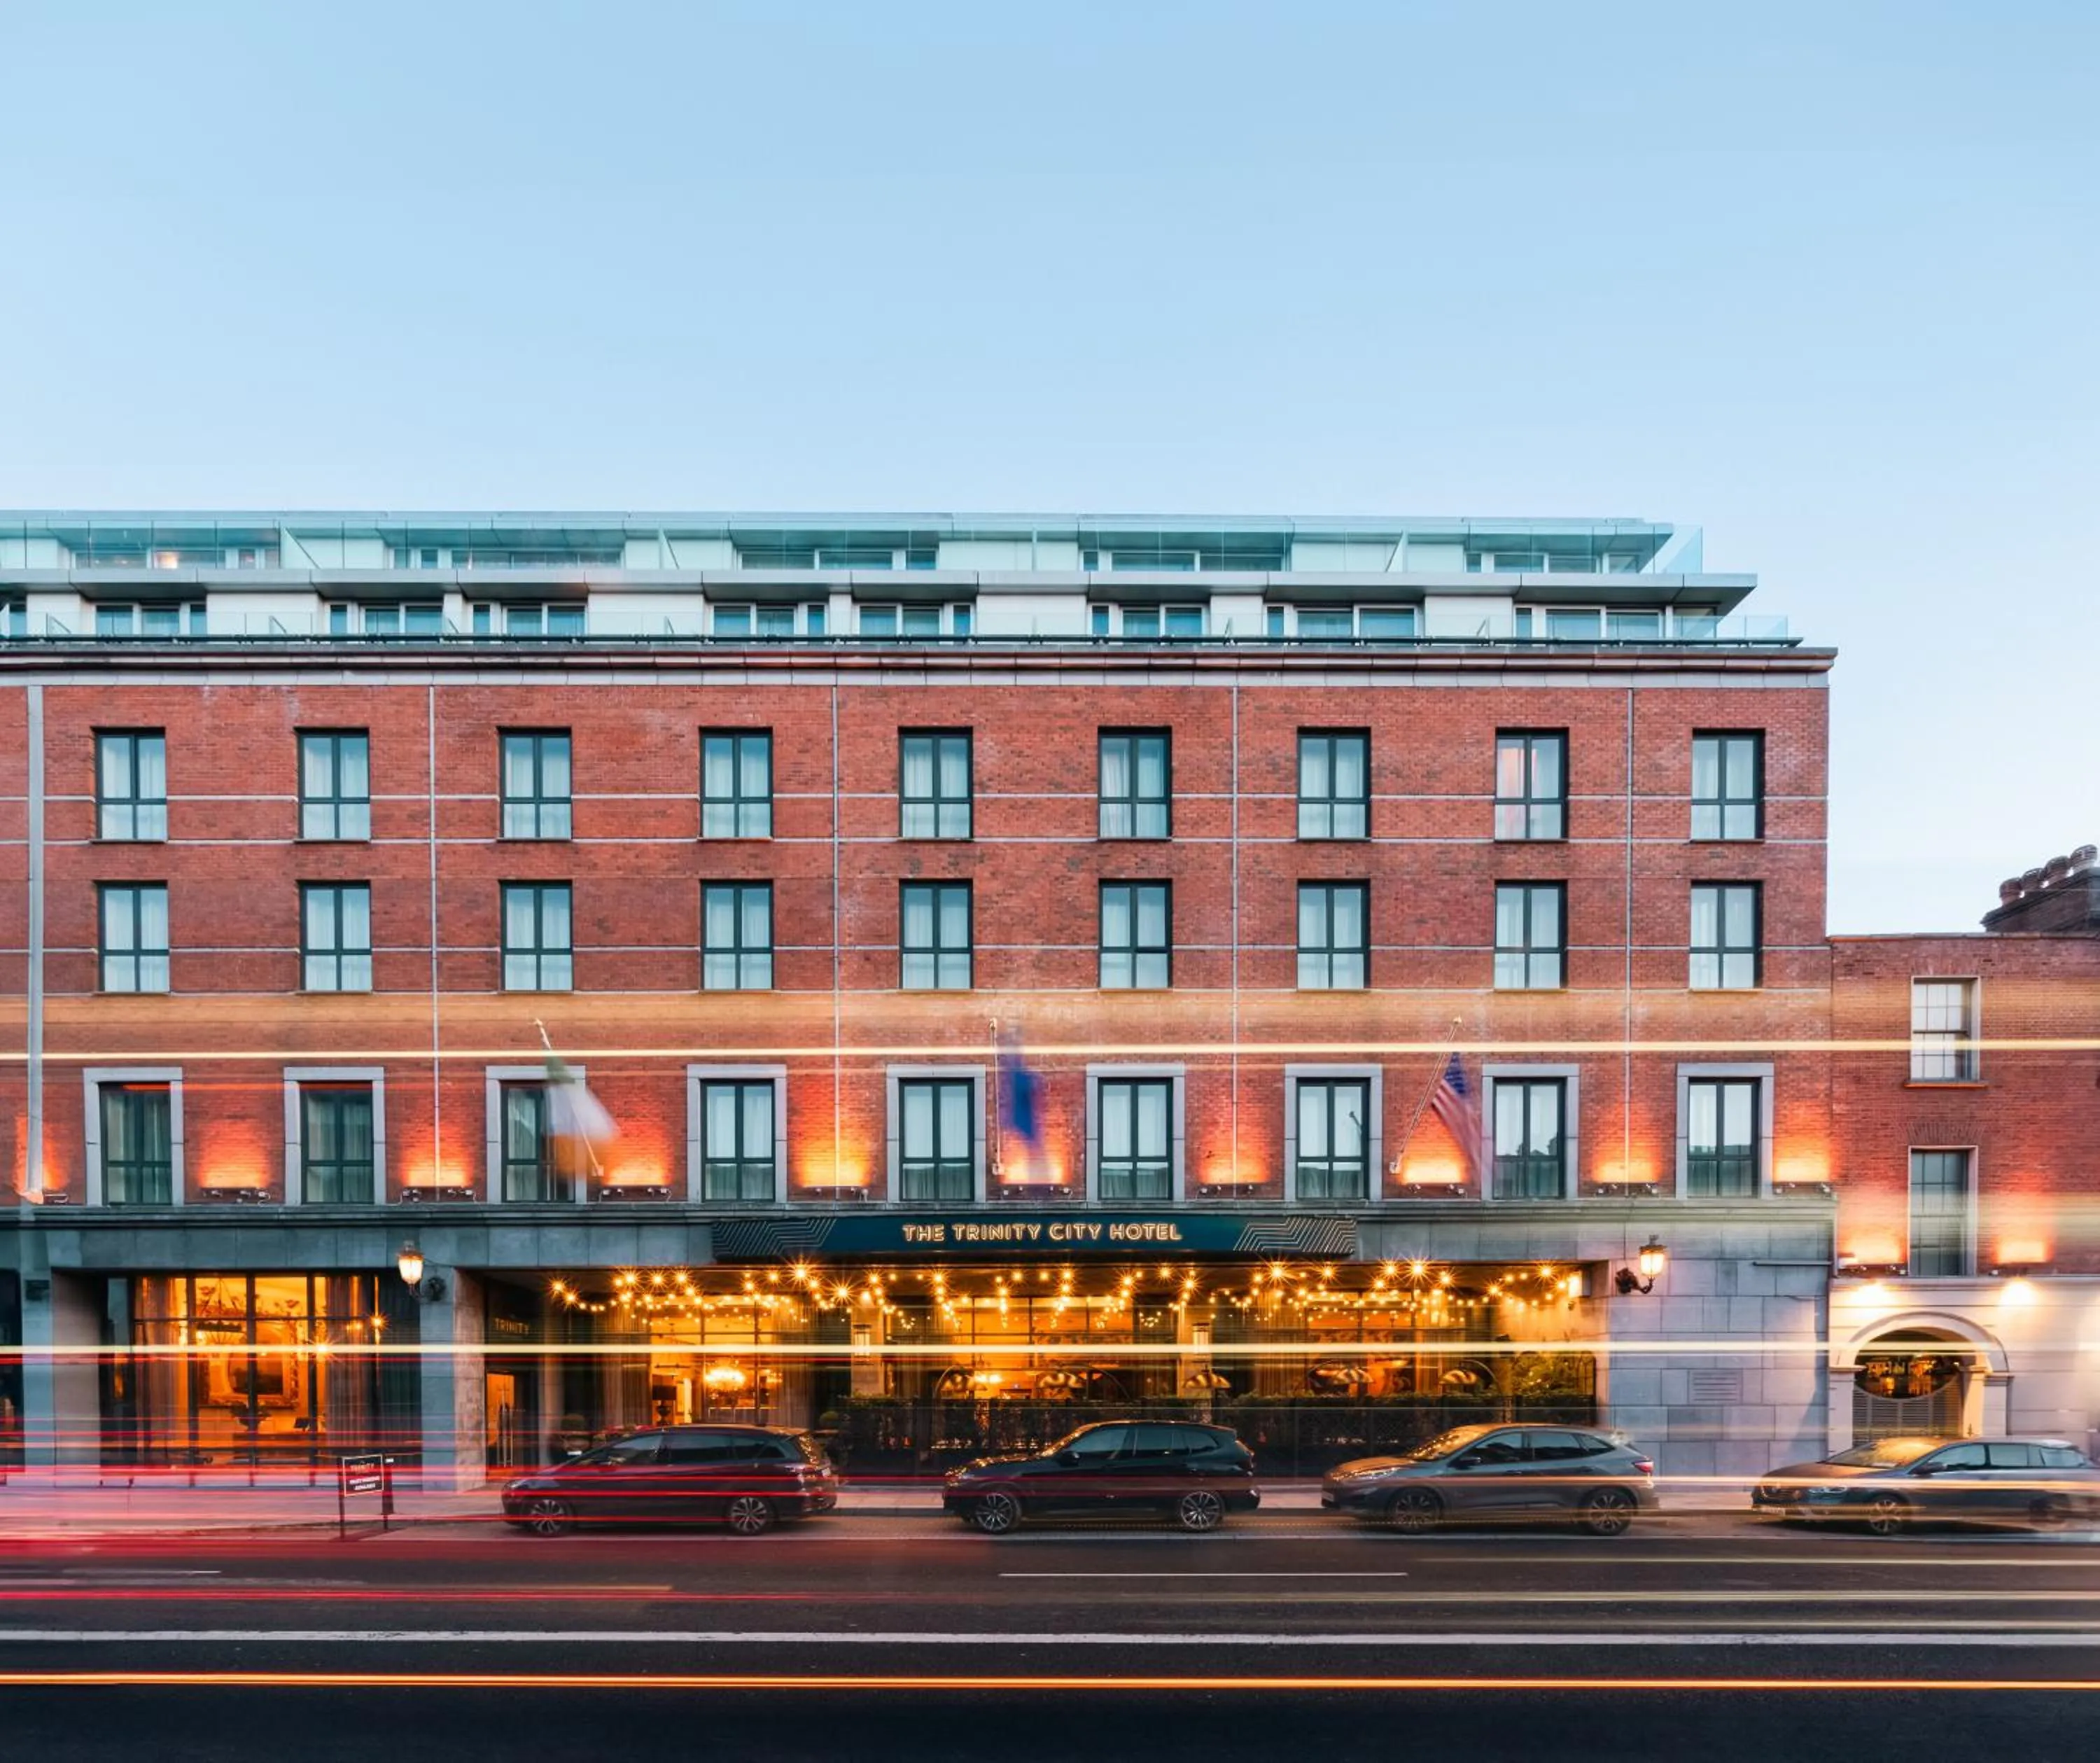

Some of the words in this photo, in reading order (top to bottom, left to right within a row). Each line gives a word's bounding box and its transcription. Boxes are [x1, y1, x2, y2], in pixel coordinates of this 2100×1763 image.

[902, 1224, 944, 1241] THE
[953, 1224, 1041, 1240] TRINITY
[1049, 1223, 1102, 1240] CITY
[1110, 1224, 1183, 1240] HOTEL
